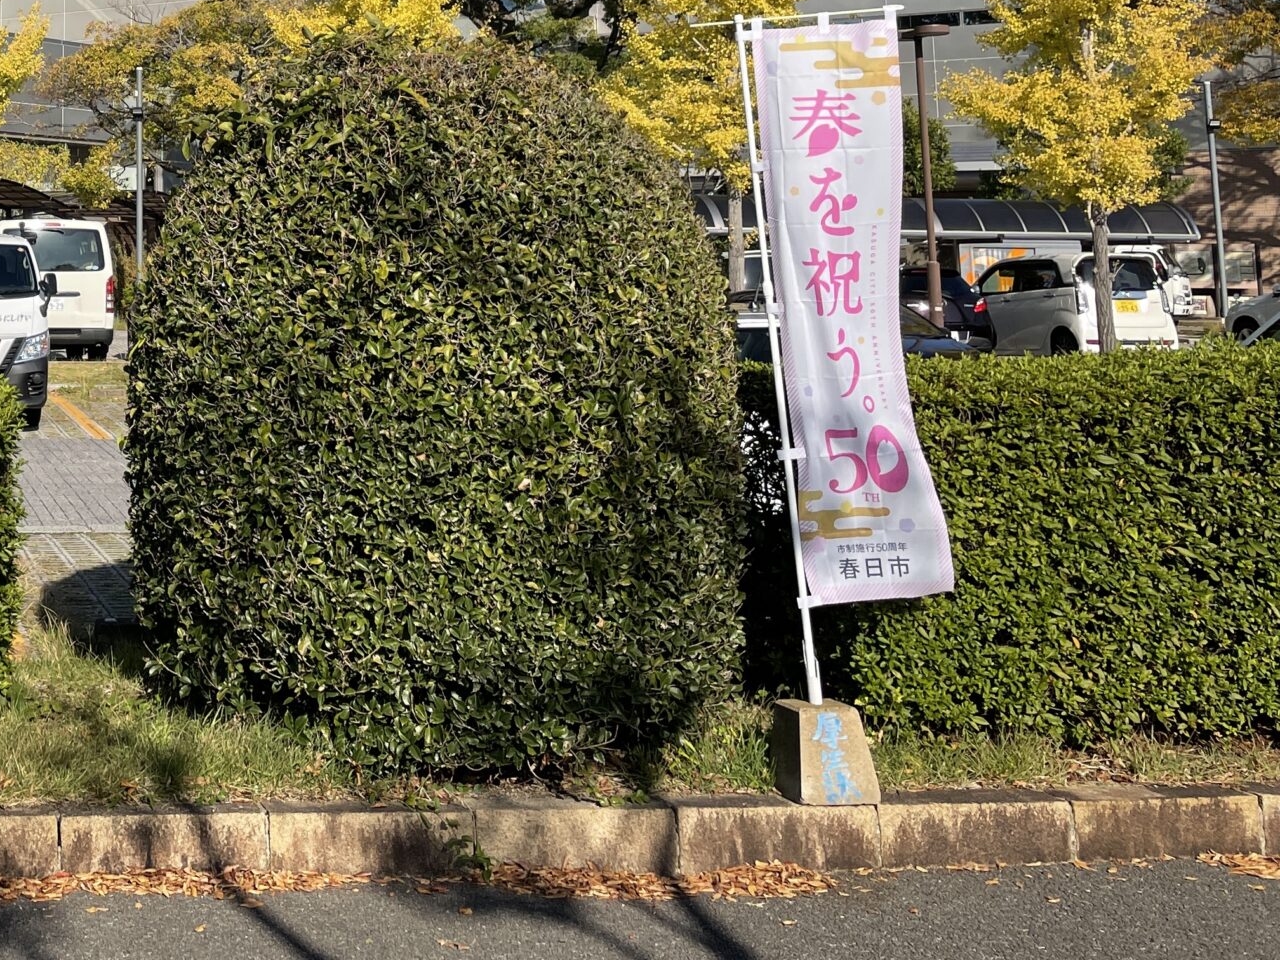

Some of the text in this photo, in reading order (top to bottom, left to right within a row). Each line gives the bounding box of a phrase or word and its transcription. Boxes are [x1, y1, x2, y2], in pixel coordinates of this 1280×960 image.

[788, 89, 875, 415] 春を祝う。
[872, 335, 888, 409] ANNIVERSARY
[825, 425, 909, 493] 50
[862, 491, 881, 503] TH
[836, 542, 908, 554] 市制施行50周年
[838, 555, 910, 580] 春日市
